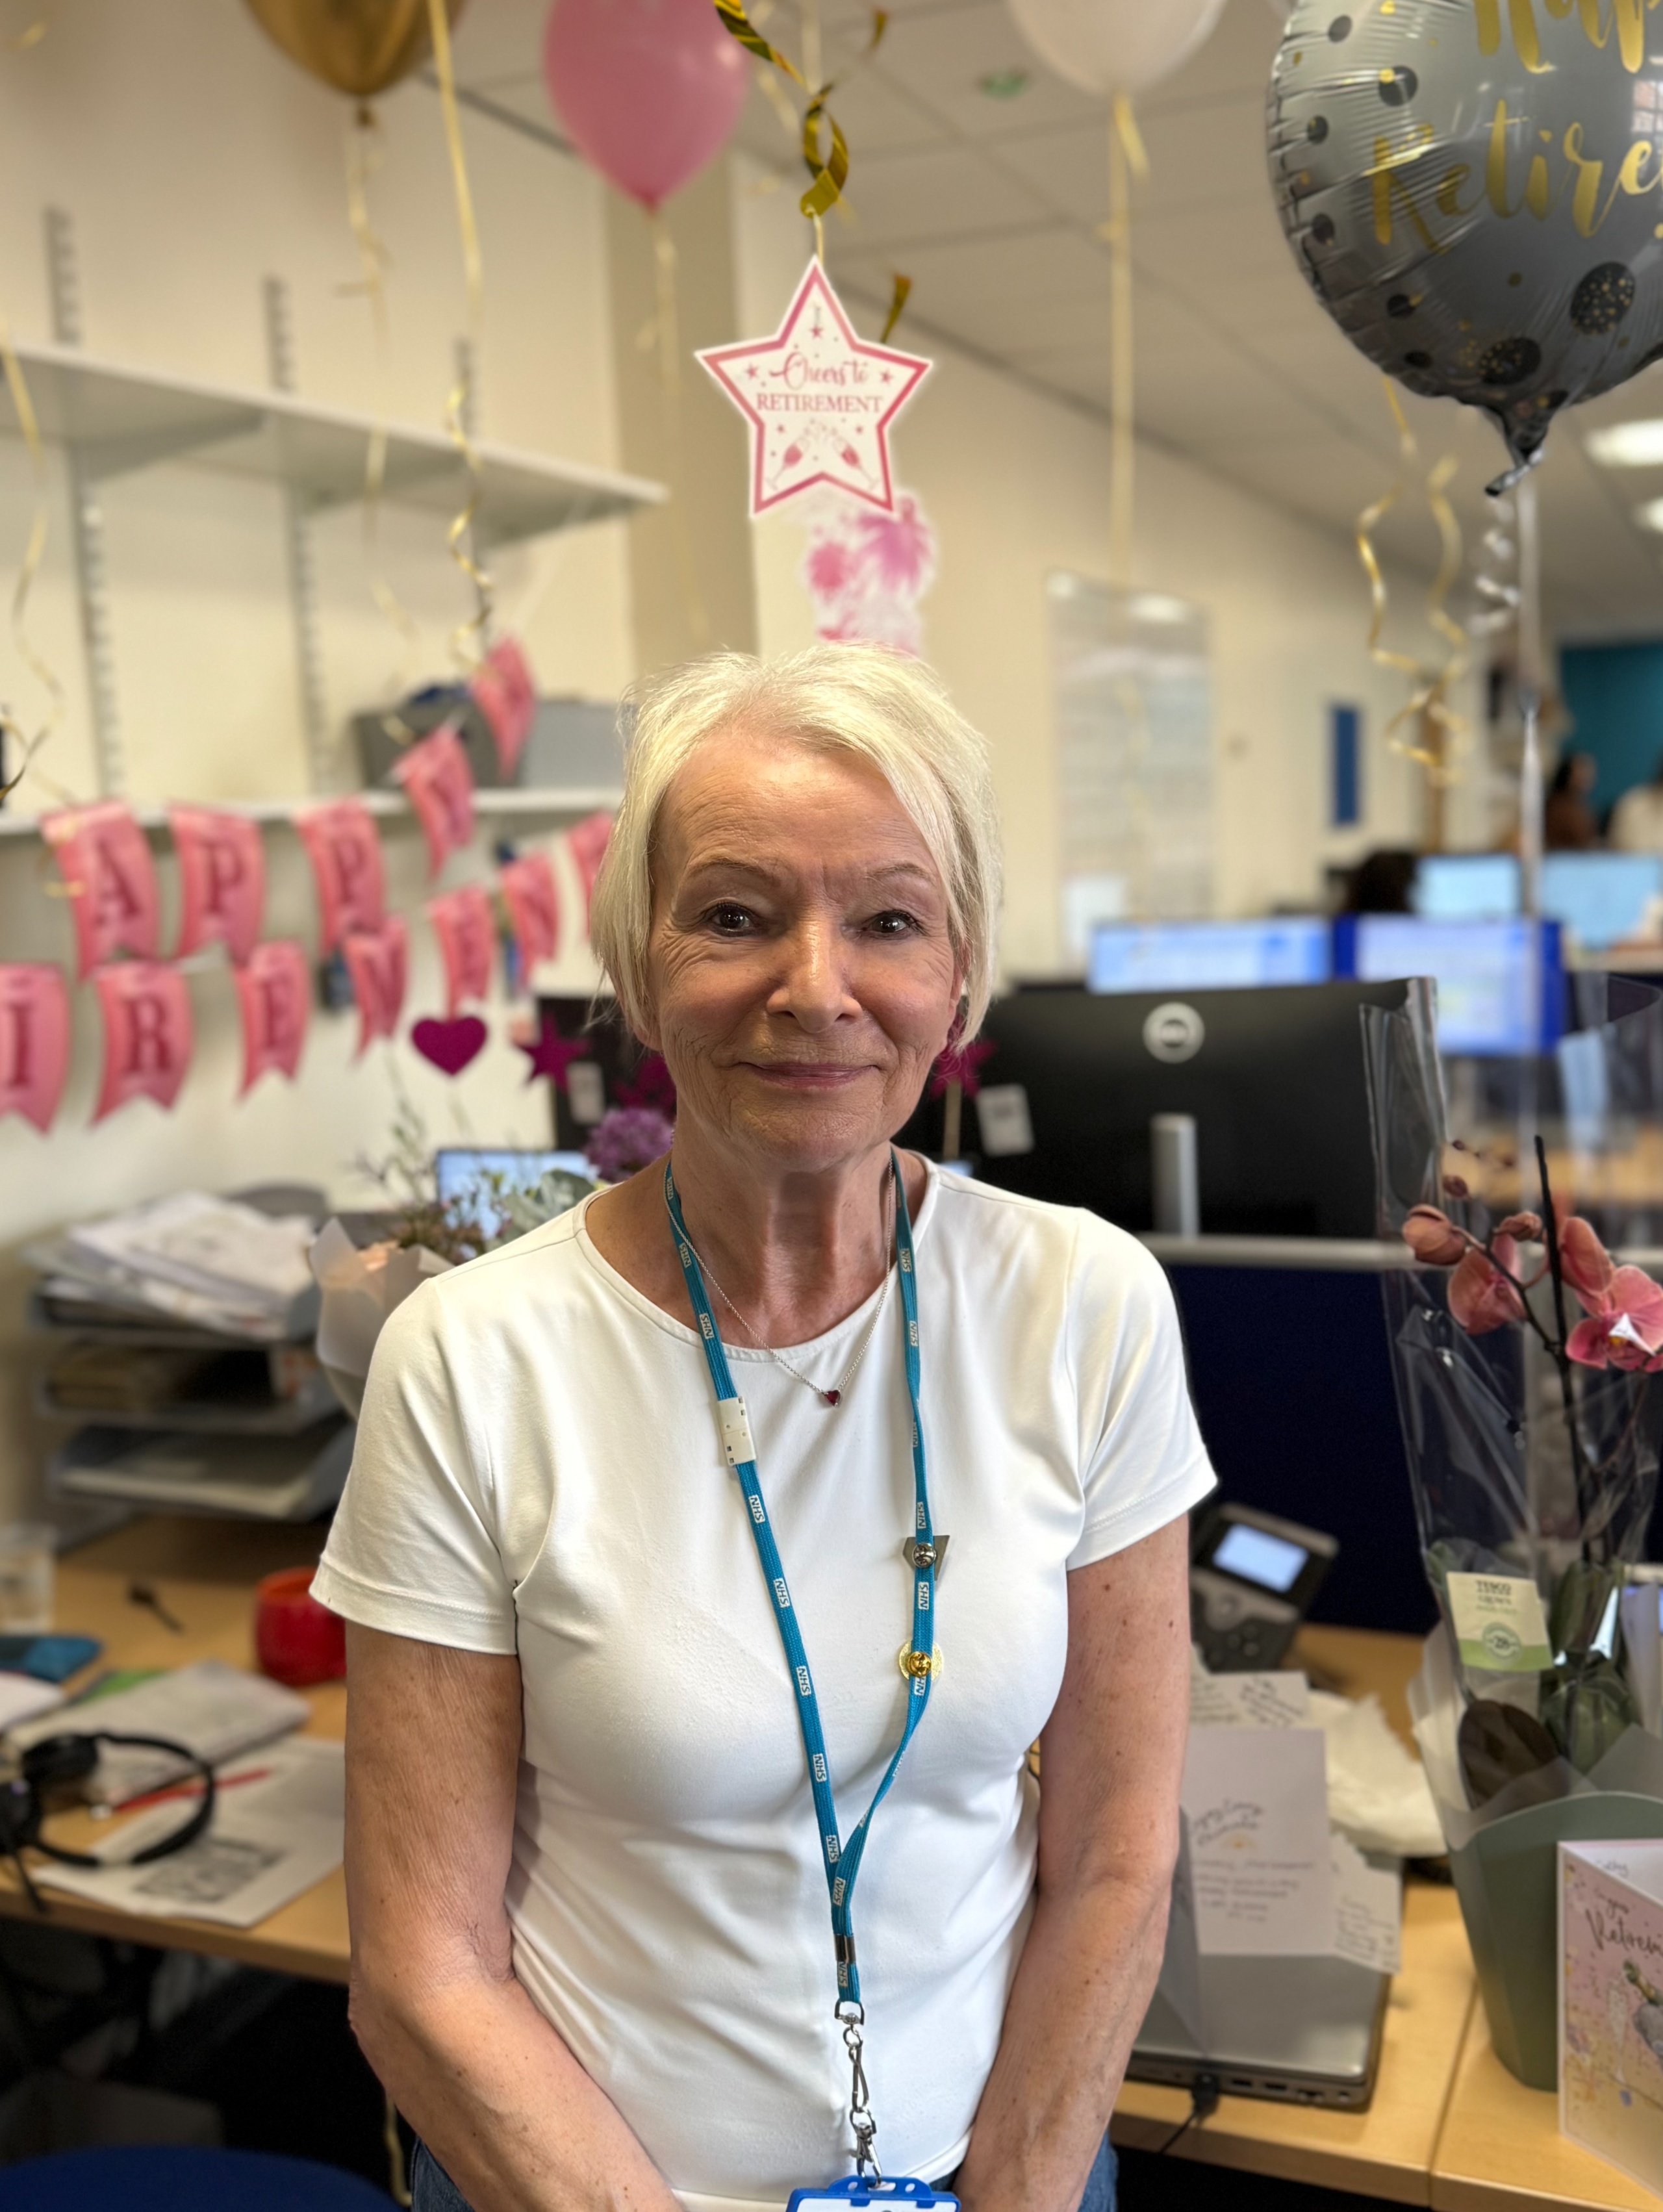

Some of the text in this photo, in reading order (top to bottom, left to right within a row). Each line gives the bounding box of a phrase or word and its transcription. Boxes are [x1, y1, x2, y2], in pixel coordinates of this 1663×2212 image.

[769, 351, 869, 390] Cheers to
[757, 393, 882, 412] RETIREMENT
[680, 1243, 691, 1267] NHS
[900, 1248, 911, 1272] NHS
[700, 1314, 713, 1338] NHS
[909, 1321, 919, 1347] NHS
[750, 1495, 765, 1522] NHS
[917, 1503, 926, 1528] NHS
[775, 1579, 789, 1607] NHS
[919, 1583, 929, 1609] NHS
[797, 1666, 811, 1696] NHS
[814, 1754, 826, 1781] NHS
[826, 1836, 839, 1862] NHS
[833, 1877, 845, 1906] NHS
